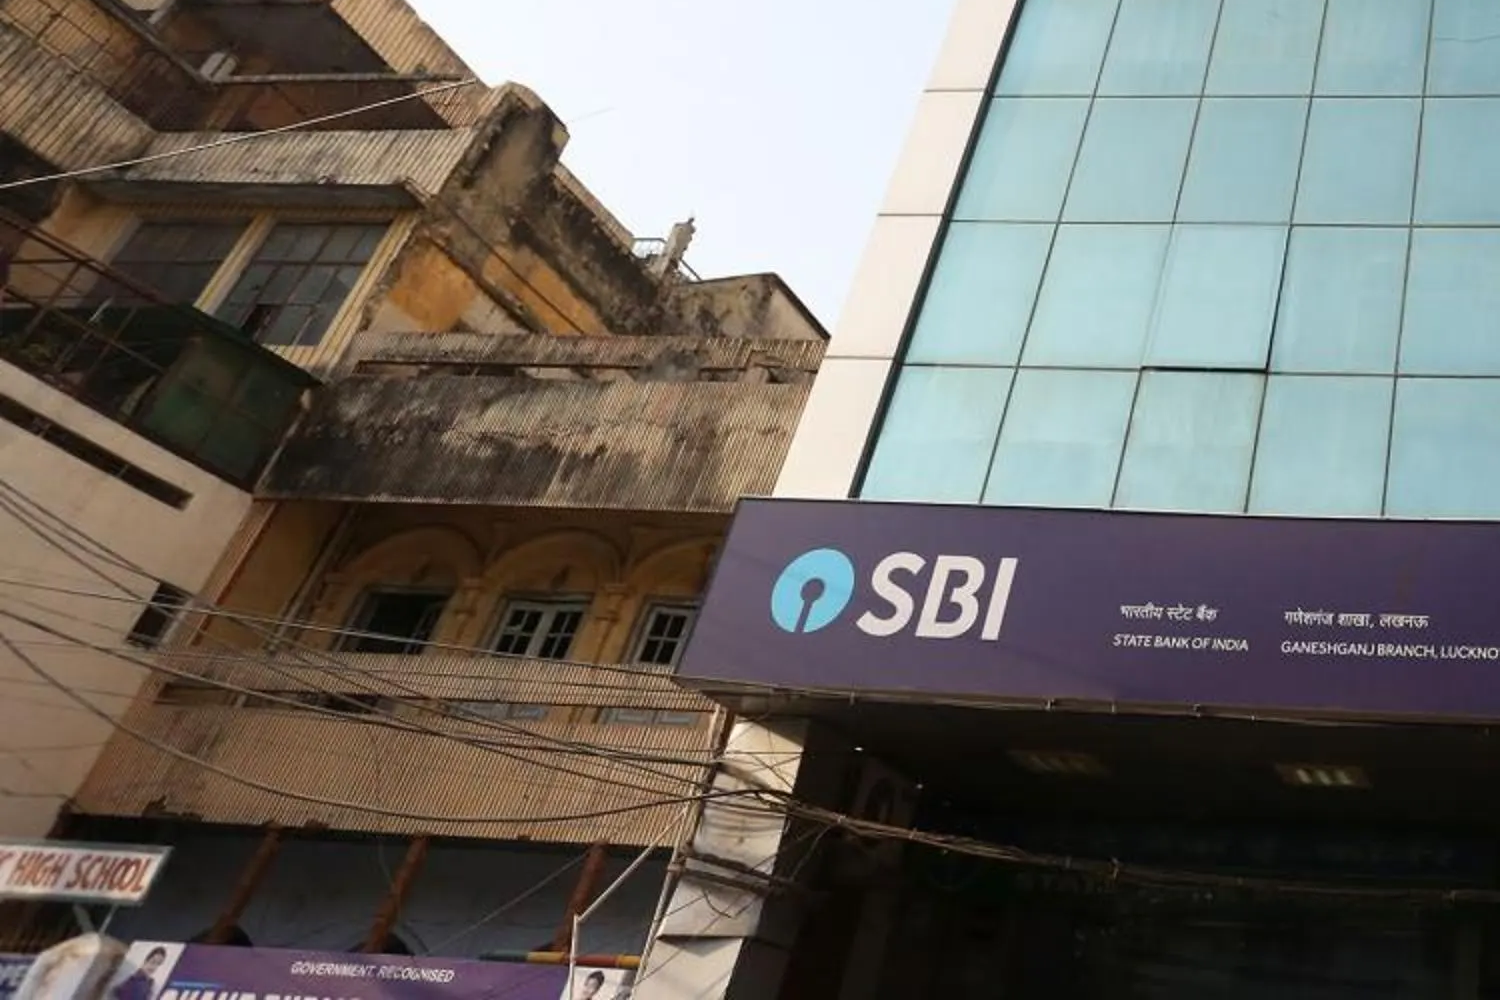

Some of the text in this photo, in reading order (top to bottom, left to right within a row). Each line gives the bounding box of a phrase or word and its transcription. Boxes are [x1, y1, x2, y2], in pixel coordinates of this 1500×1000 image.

[856, 551, 1019, 640] SBI
[1119, 601, 1219, 622] भारतीय स्टेट बैंक
[1283, 608, 1335, 627] गणेशगंज
[1379, 614, 1430, 629] लखनऊ
[1113, 633, 1249, 651] STATE BANK OF INDIA
[1280, 640, 1375, 657] GANESHGANJ
[5, 852, 71, 887] HIGH
[64, 853, 152, 893] SCHOOL
[290, 961, 456, 985] GOVERNMENT RECOGNISED
